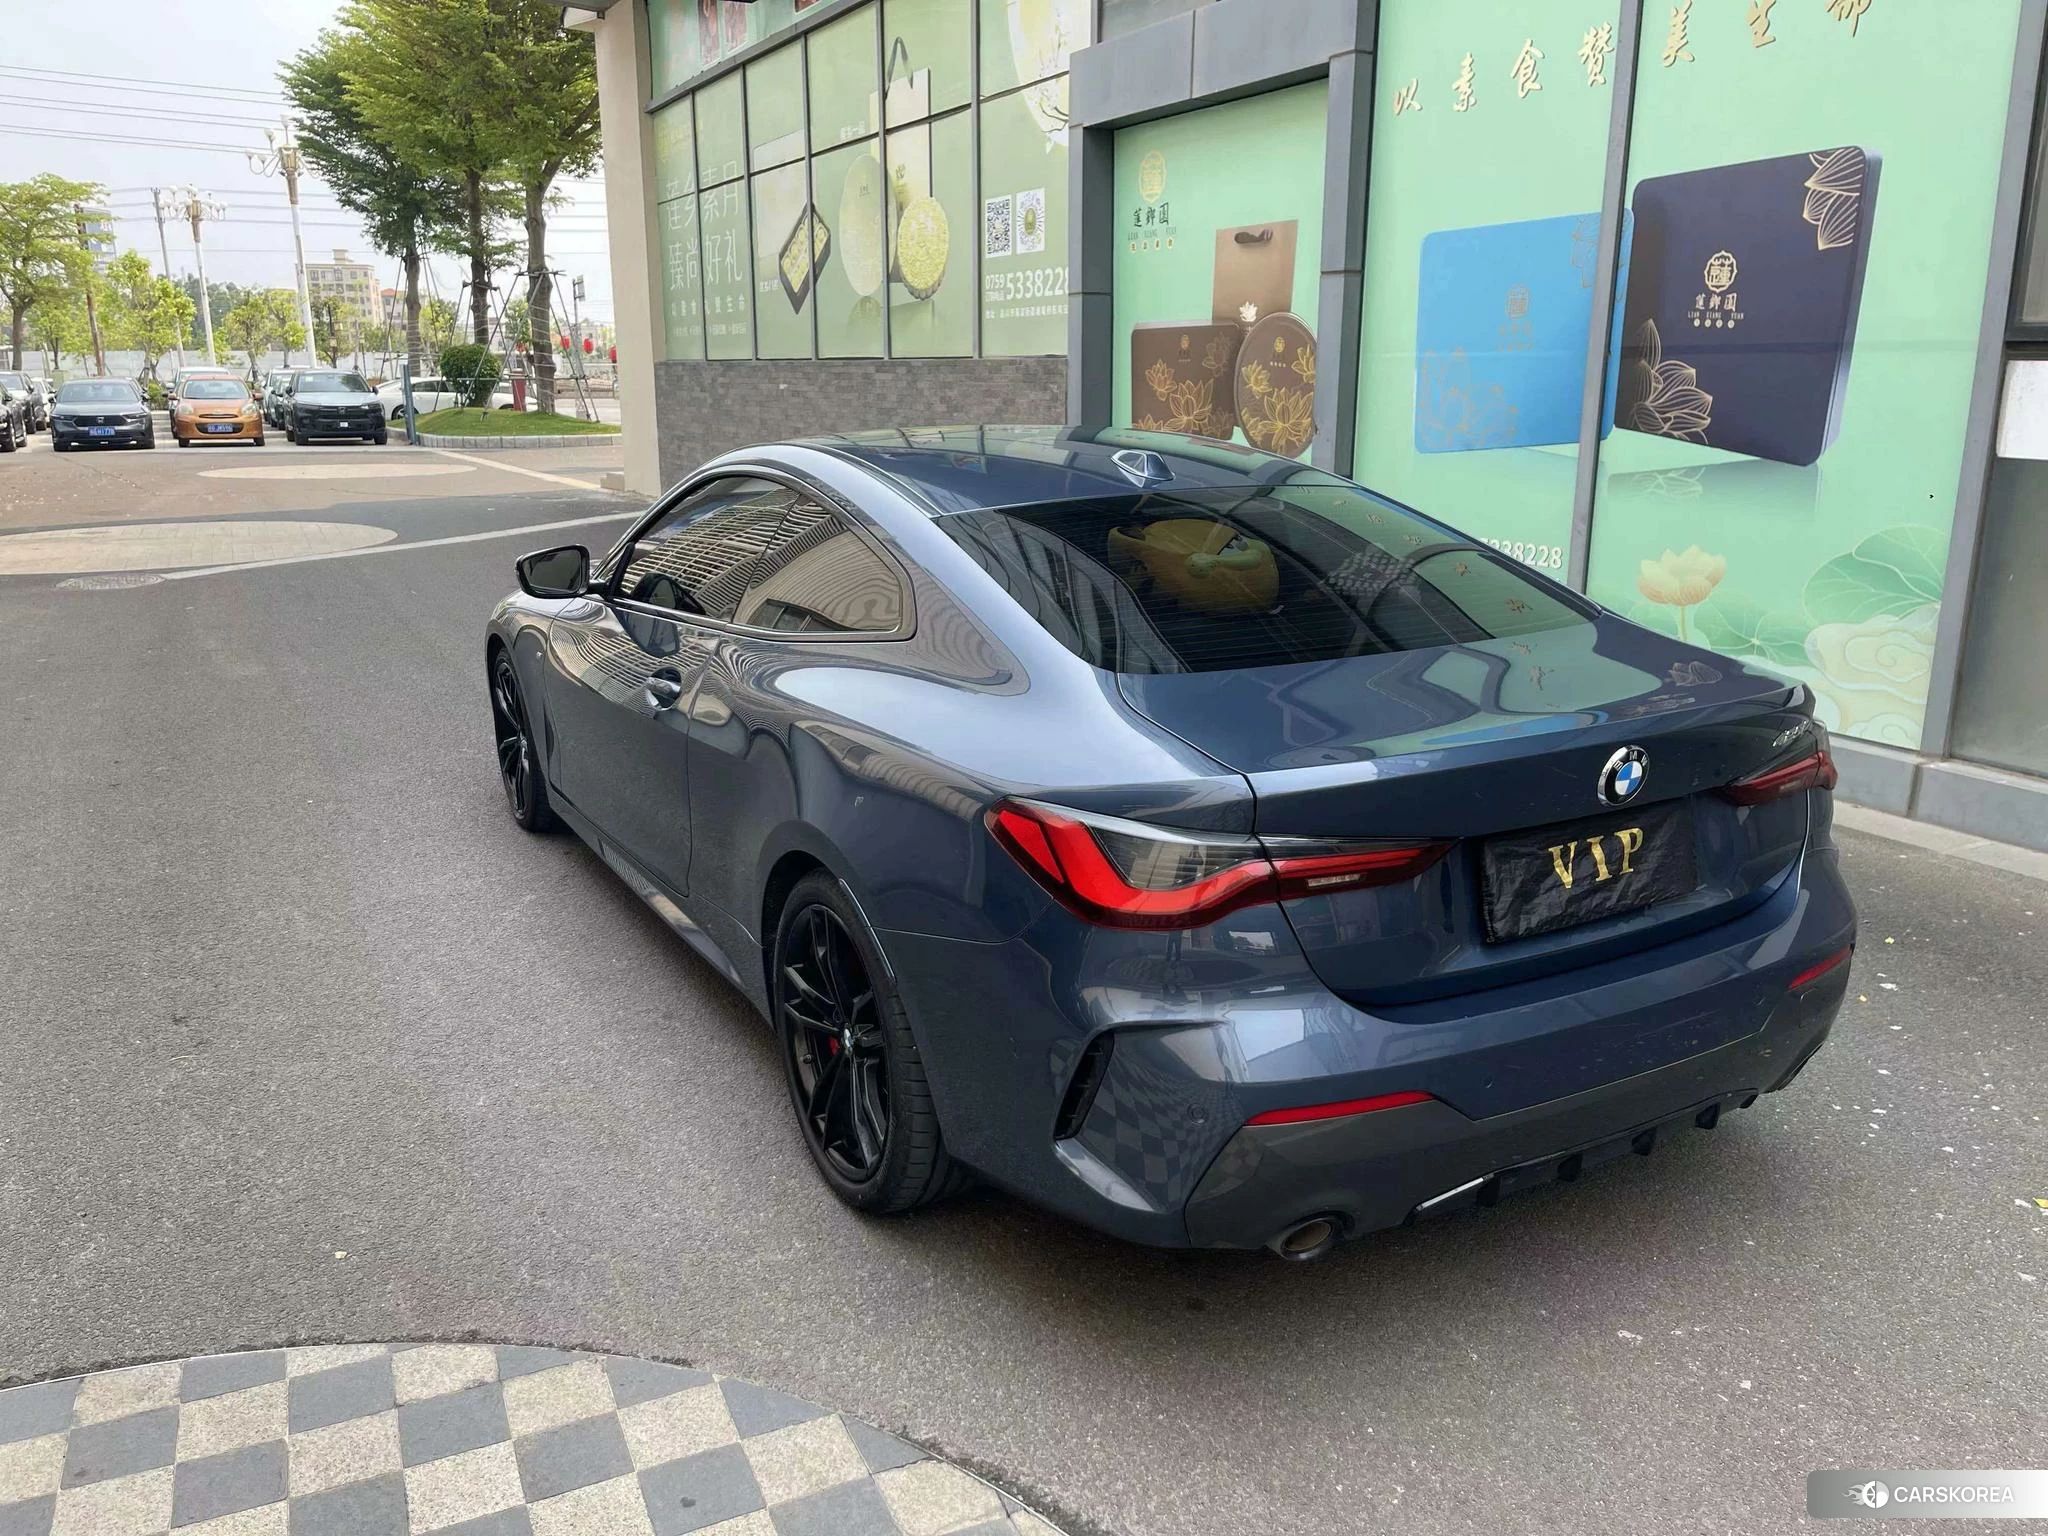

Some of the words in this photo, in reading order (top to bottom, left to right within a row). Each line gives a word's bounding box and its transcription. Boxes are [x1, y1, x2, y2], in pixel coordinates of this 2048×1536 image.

[985, 273, 1005, 290] 0759
[1687, 311, 1700, 319] LIAN
[1731, 312, 1745, 320] YUAN
[1548, 827, 1645, 889] VIP
